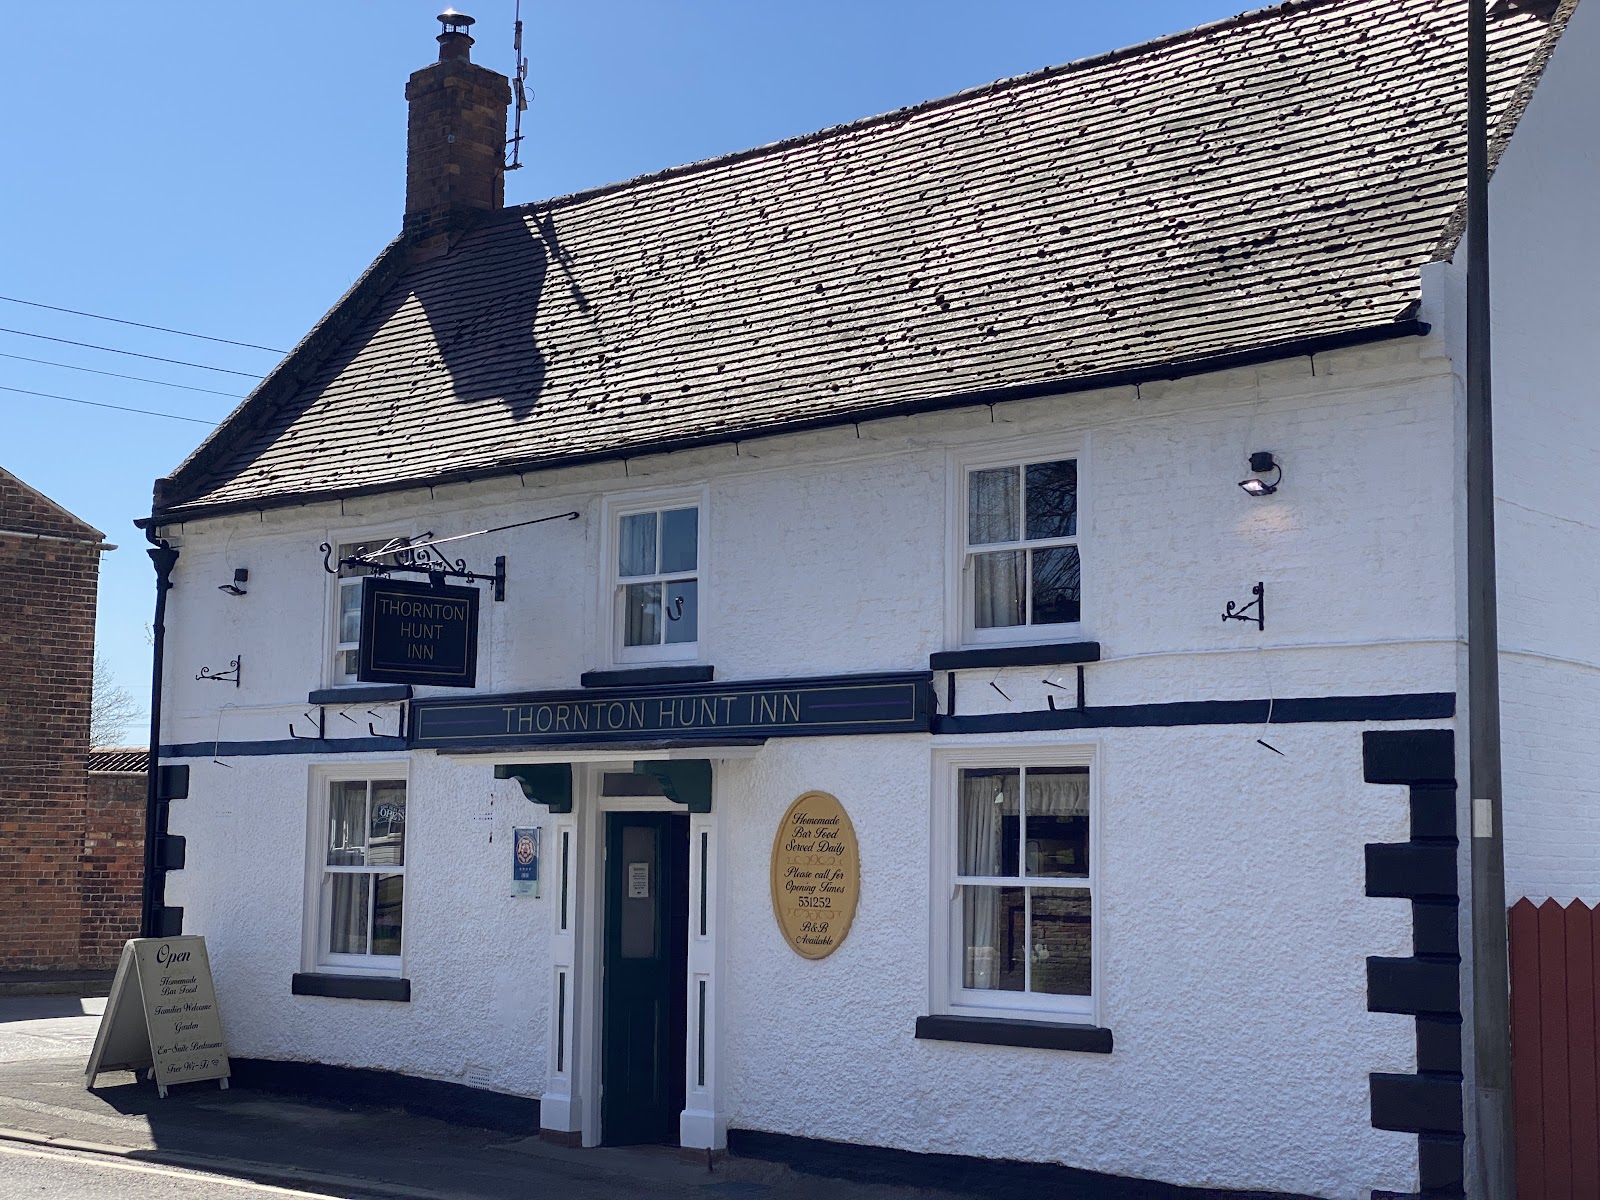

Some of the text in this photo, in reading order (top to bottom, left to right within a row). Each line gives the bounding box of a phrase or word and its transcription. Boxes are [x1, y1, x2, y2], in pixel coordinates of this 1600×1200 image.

[380, 599, 464, 621] THORNTON
[401, 622, 443, 640] HUNT
[408, 644, 434, 660] INN
[502, 693, 800, 733] THORNTON HUNT INN
[791, 812, 840, 826] Homemade
[791, 826, 839, 839] Bar Food
[785, 839, 845, 856] Served Daily
[784, 866, 845, 882] Please call for
[785, 880, 846, 894] Opening Times
[798, 896, 832, 908] 531252
[800, 921, 829, 934] B&B
[795, 934, 834, 946] Available
[156, 943, 191, 969] Open
[160, 976, 197, 986] Homemade
[161, 985, 198, 996] Bar Food
[154, 1003, 212, 1016] Families Welcome
[174, 1021, 199, 1034] Garden
[157, 1041, 223, 1055] En-Suite Bedrooms
[166, 1059, 210, 1074] Free Wi-Fi
